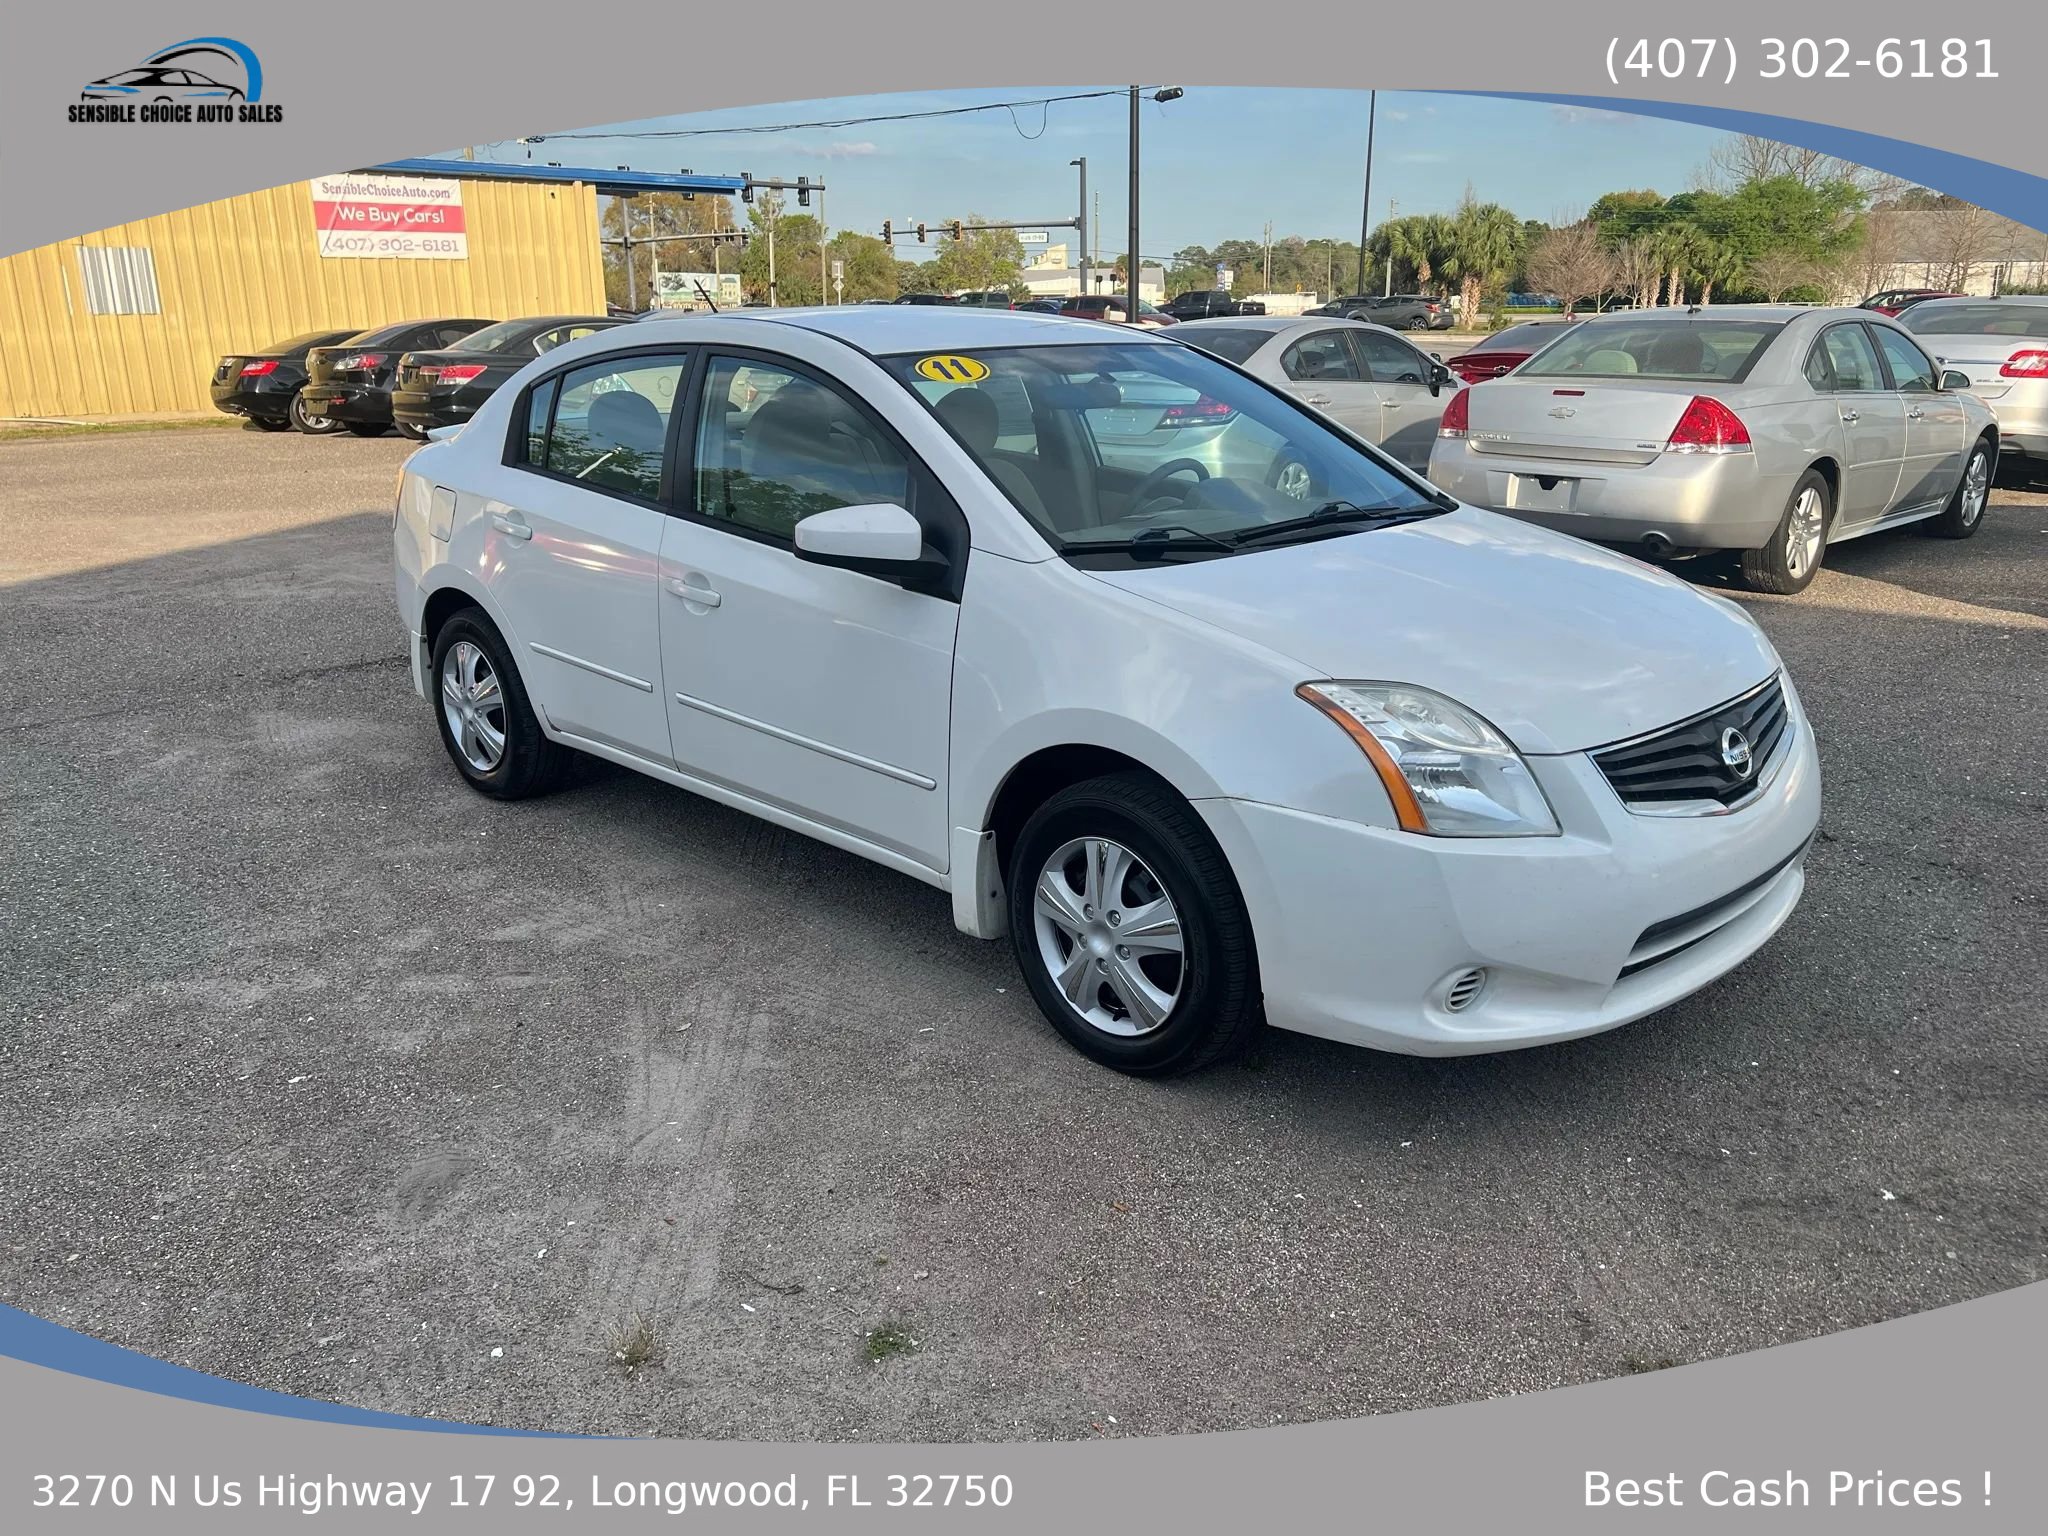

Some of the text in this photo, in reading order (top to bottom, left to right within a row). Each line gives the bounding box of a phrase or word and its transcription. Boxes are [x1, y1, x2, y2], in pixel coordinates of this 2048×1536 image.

[322, 183, 451, 199] SensibleChoiceAuto.com
[338, 206, 444, 225] We Buy Cars!
[326, 238, 459, 252] (407) 302-6181
[932, 358, 972, 380] 11
